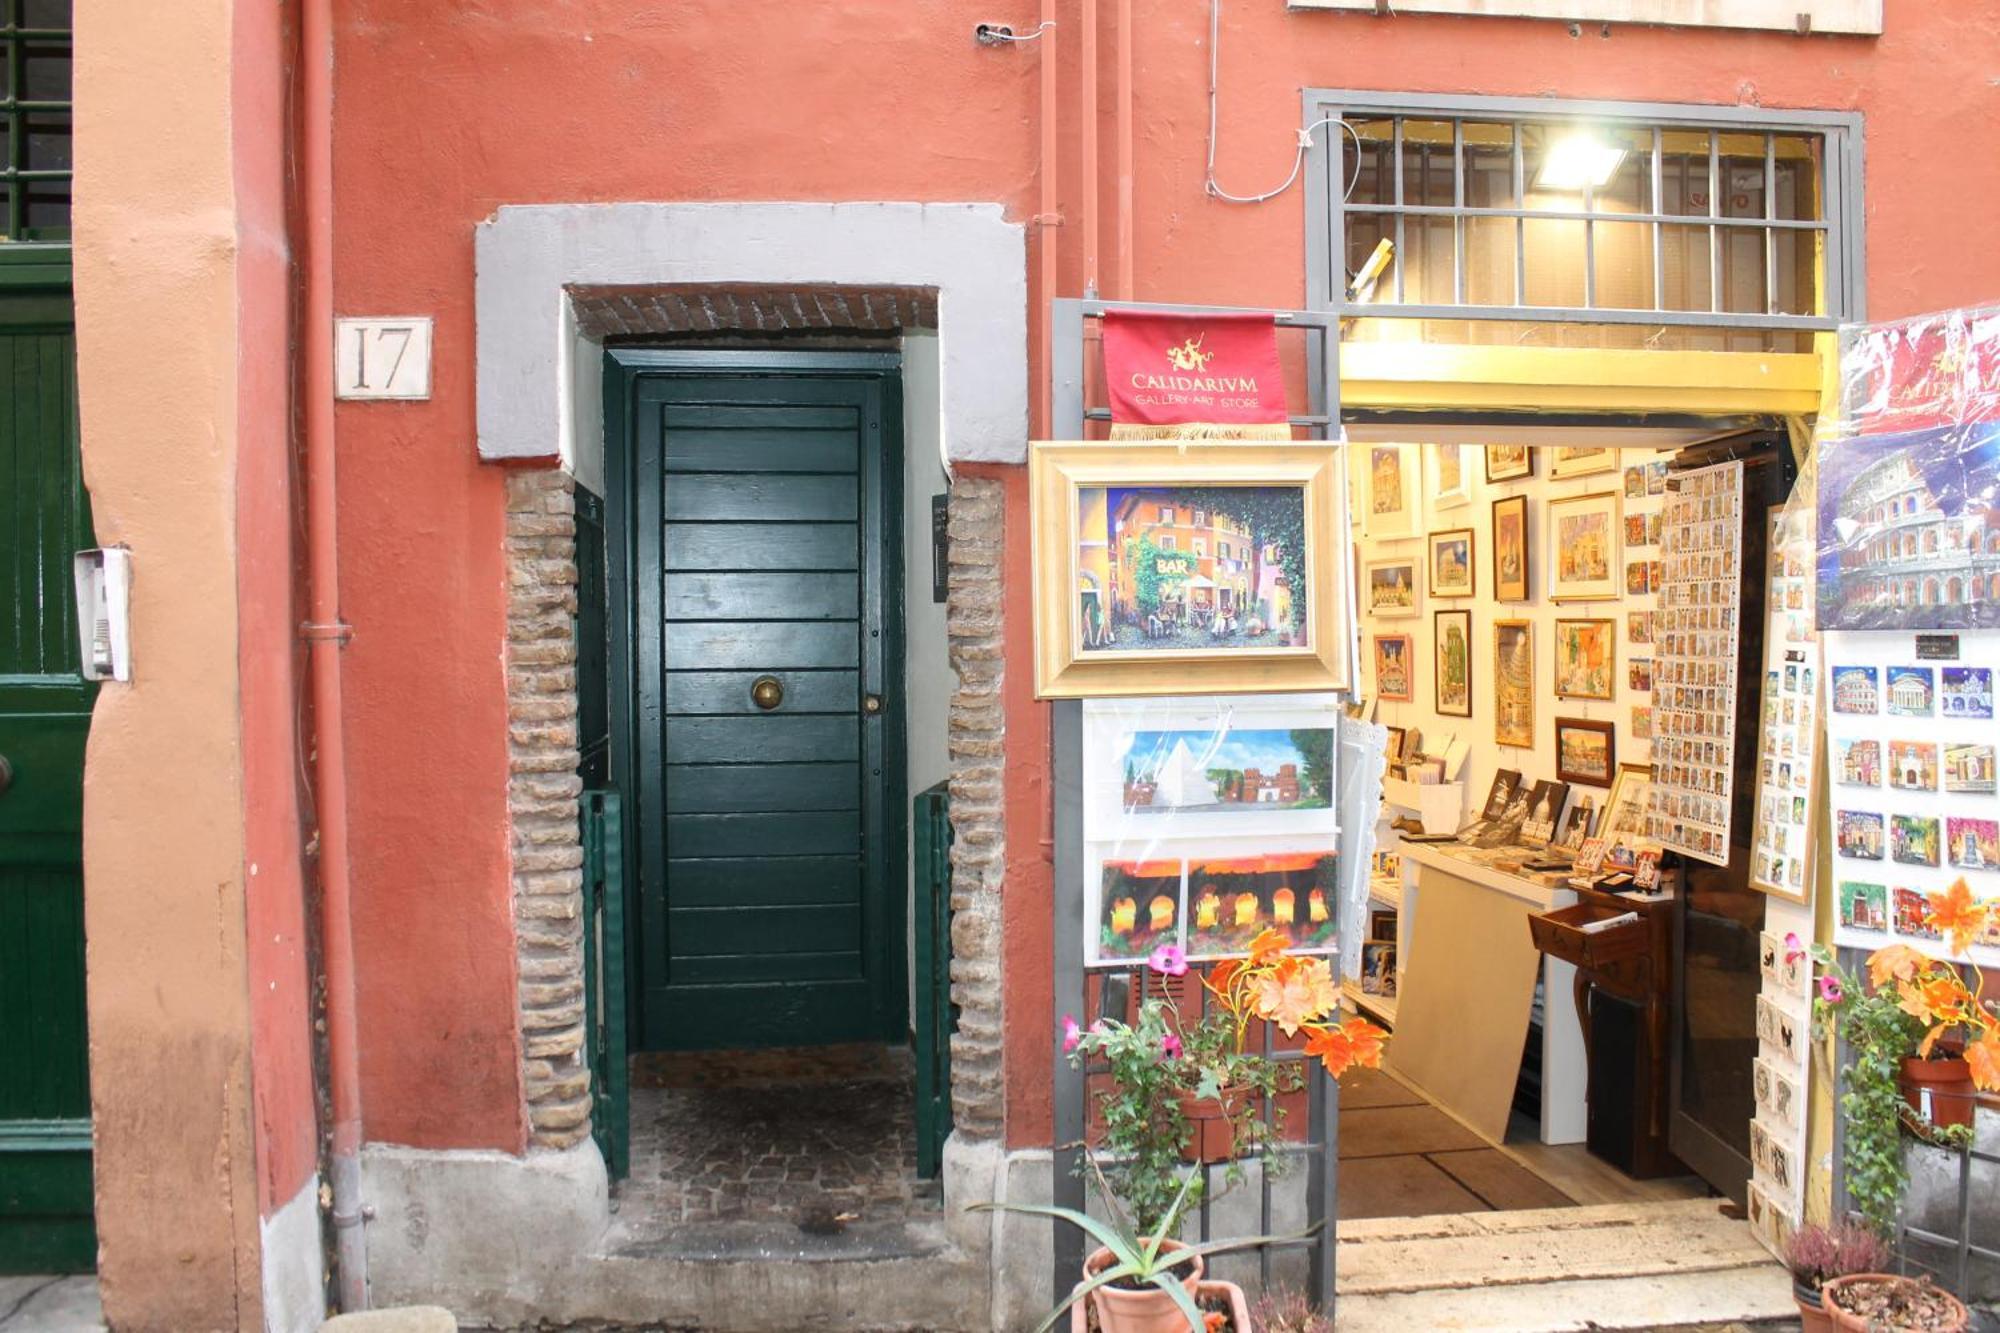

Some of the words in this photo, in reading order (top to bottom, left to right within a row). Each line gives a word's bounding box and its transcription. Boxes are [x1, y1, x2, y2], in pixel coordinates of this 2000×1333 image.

[352, 328, 412, 389] 17
[1132, 373, 1258, 393] CALIDARIVM
[1220, 398, 1259, 408] STORE
[1157, 559, 1188, 574] BAR
